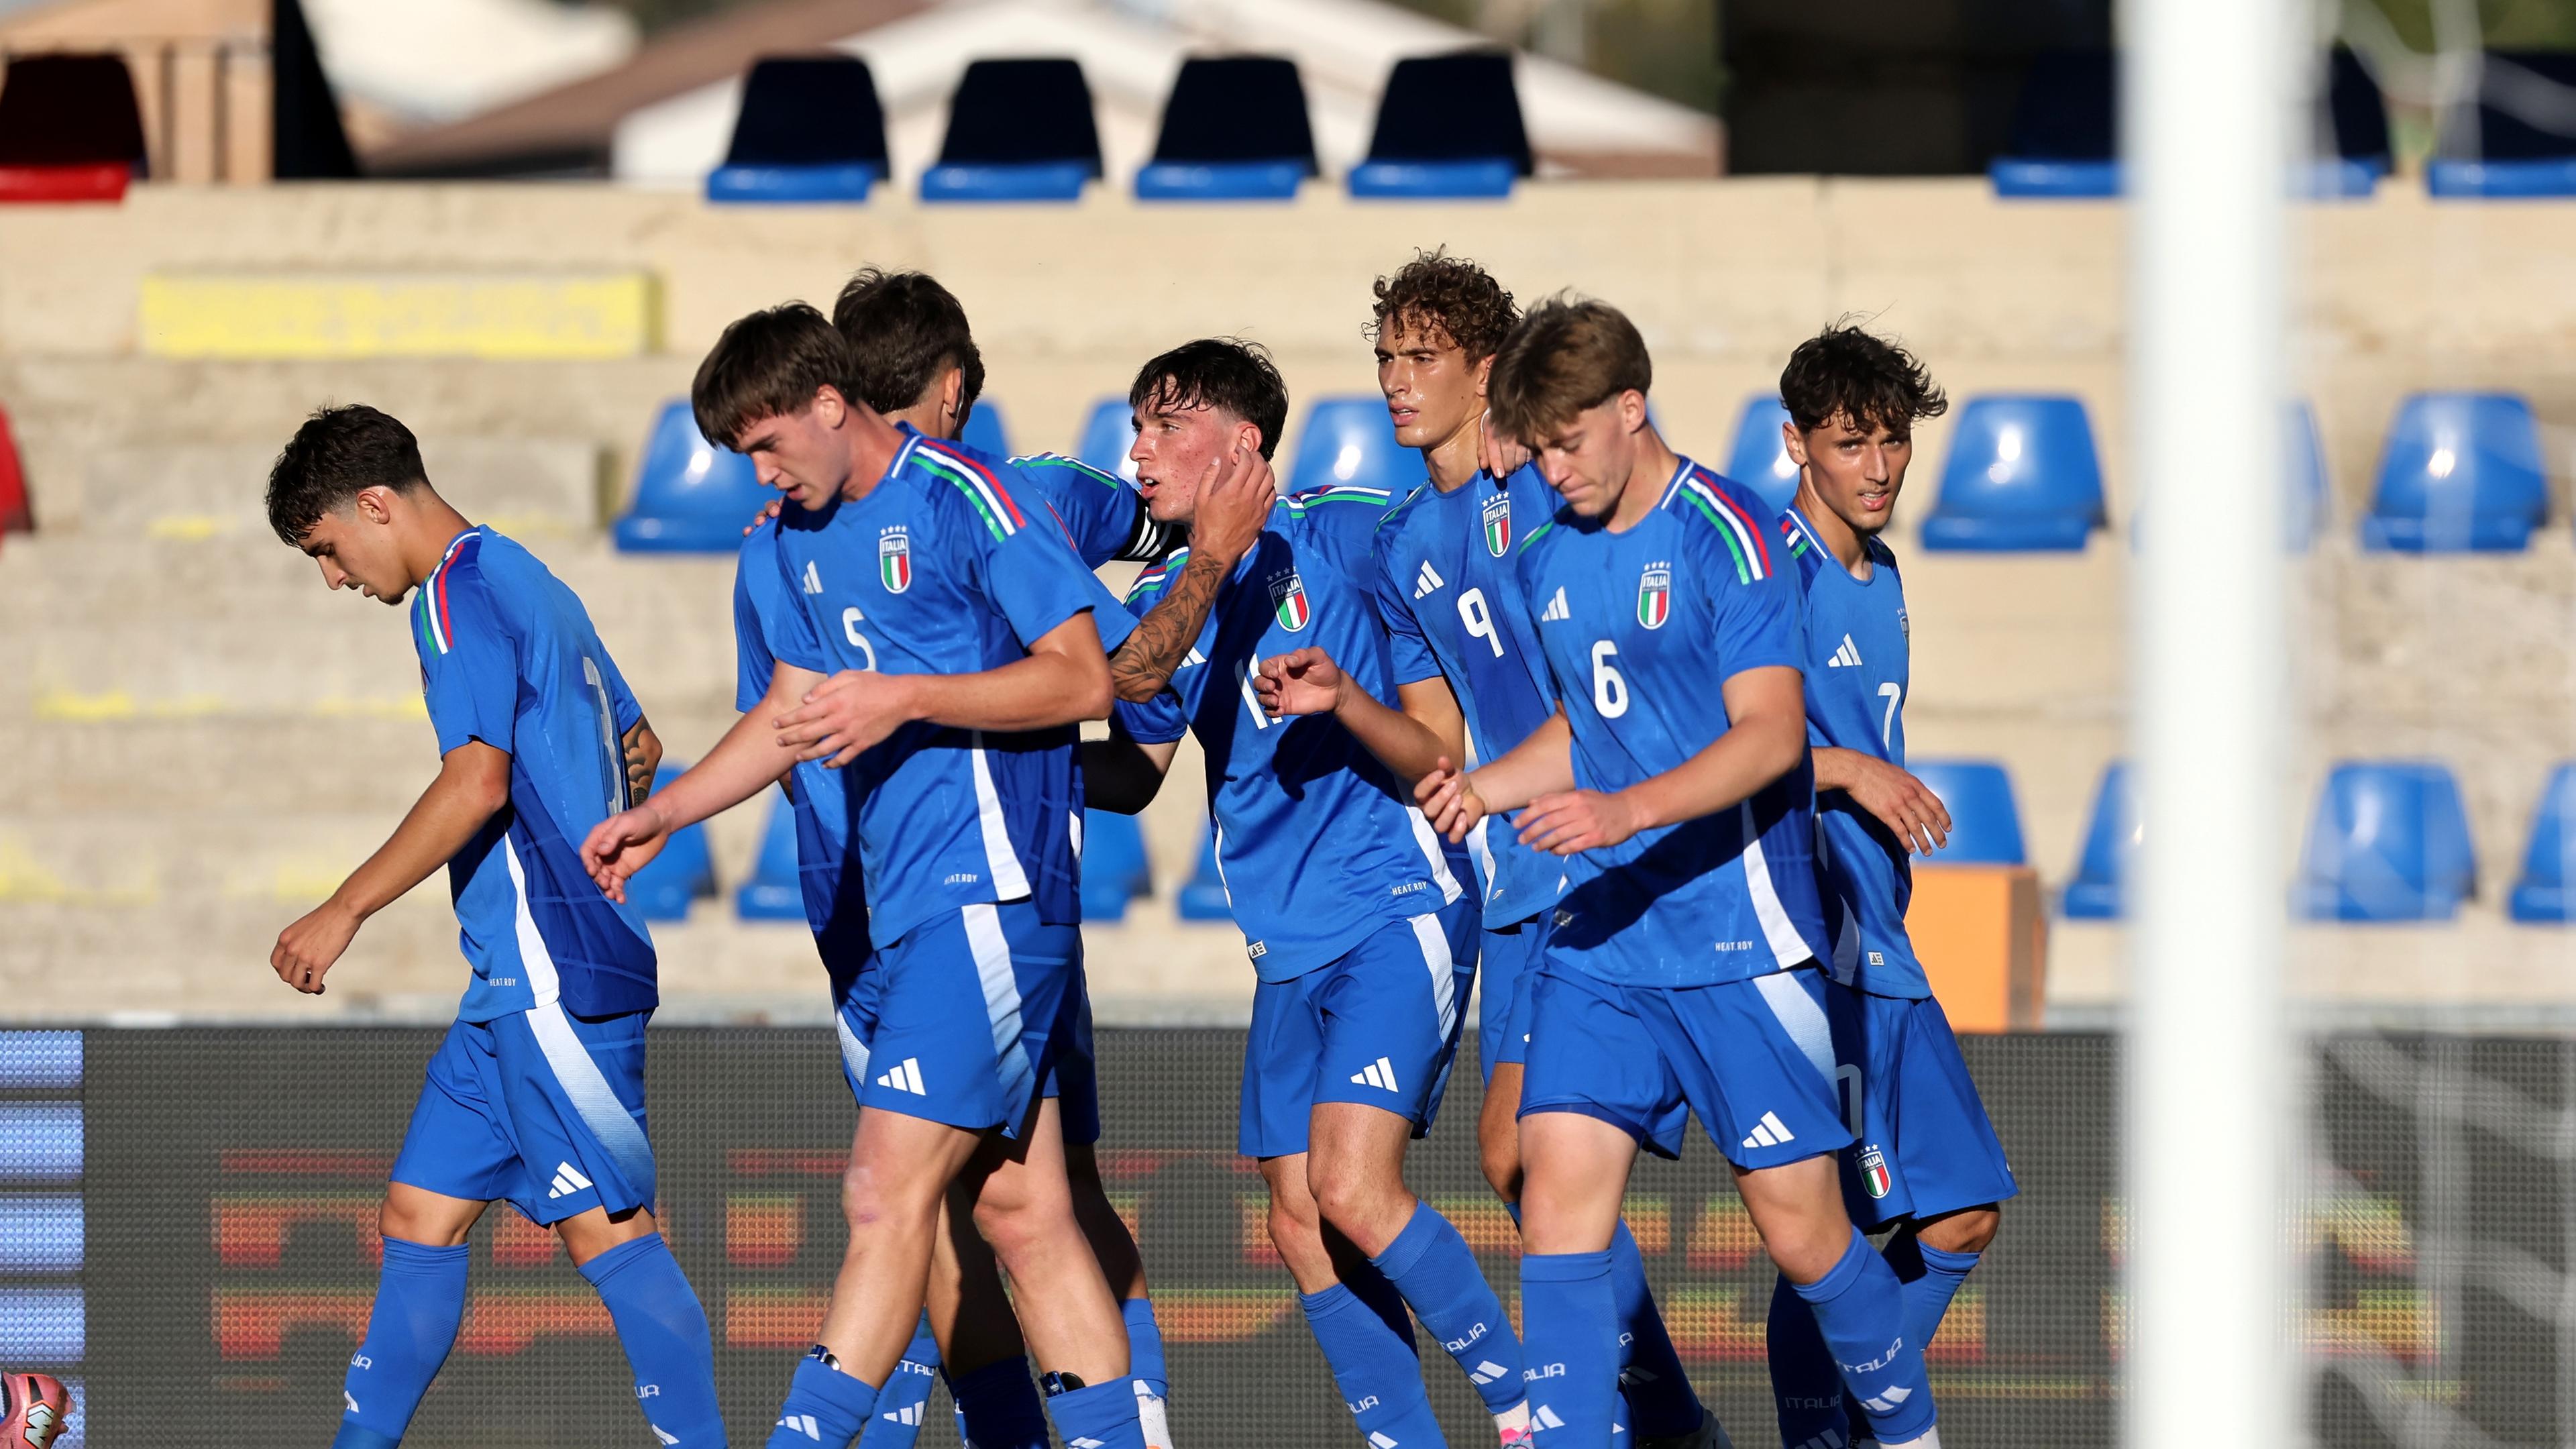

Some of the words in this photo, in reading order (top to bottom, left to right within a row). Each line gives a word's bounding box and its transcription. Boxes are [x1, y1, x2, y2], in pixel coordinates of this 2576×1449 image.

[1486, 504, 1507, 523] ITALIA
[881, 539, 906, 552] ITALIA
[1272, 578, 1300, 597] ITALIA
[1642, 575, 1667, 588] ITALIA
[1458, 588, 1505, 658] 9
[843, 606, 877, 672] 5
[1592, 640, 1629, 719] 6
[1878, 682, 1900, 751] 7
[1858, 1155, 1882, 1171] ITALIA
